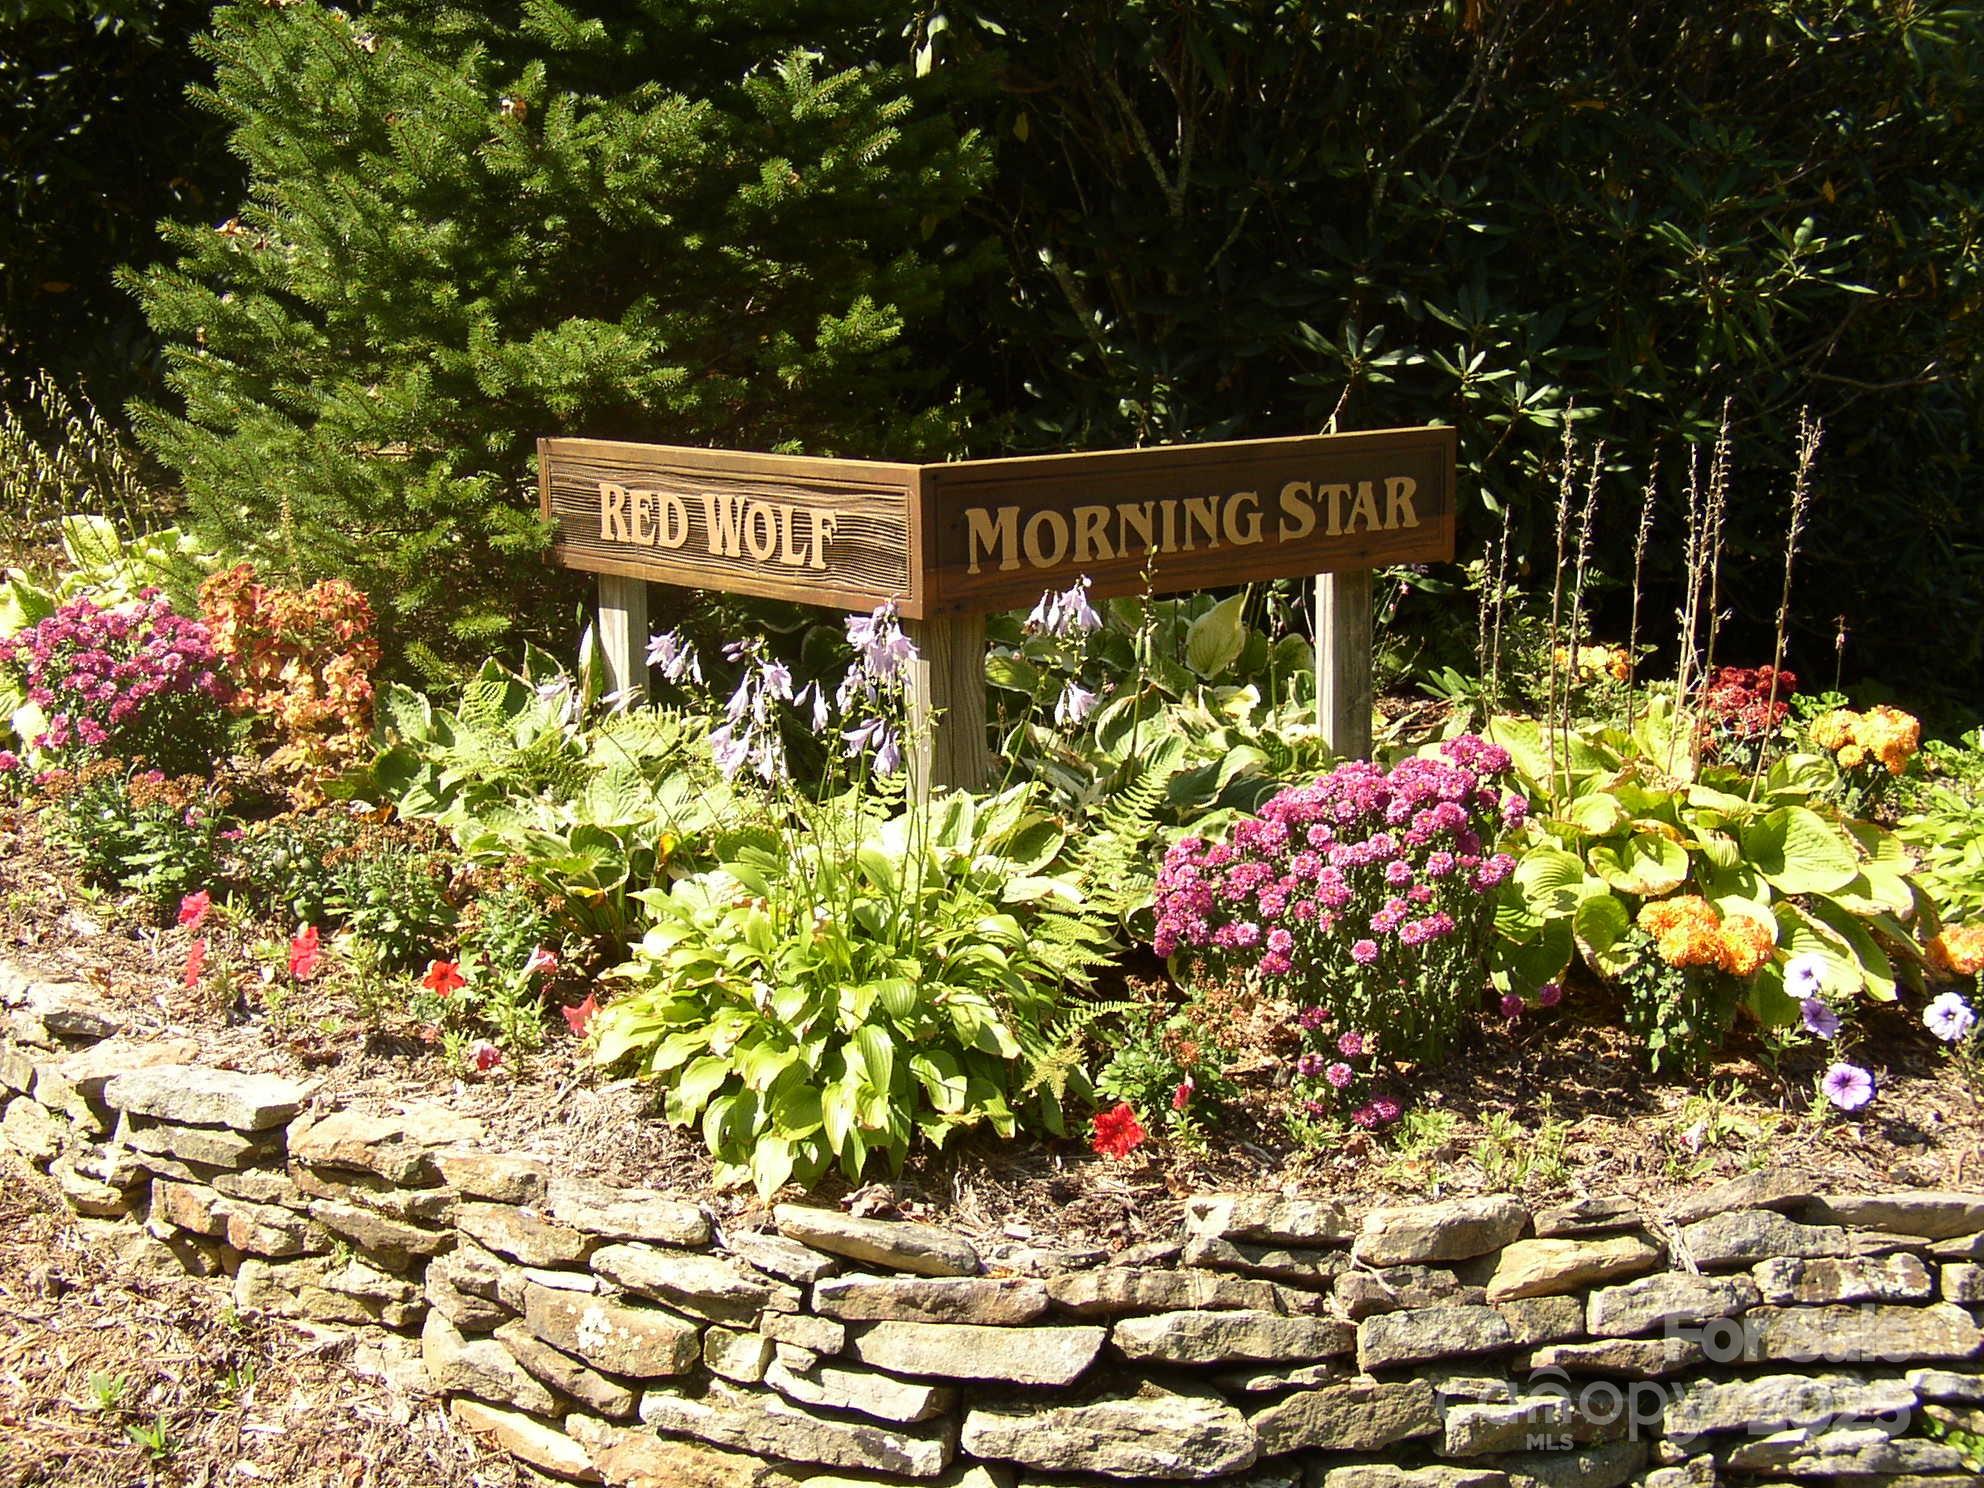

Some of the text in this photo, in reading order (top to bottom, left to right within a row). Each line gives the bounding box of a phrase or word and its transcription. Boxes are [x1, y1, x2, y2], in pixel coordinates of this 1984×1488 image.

[599, 483, 838, 570] RED WOLF
[965, 476, 1421, 576] MORNING STAR
